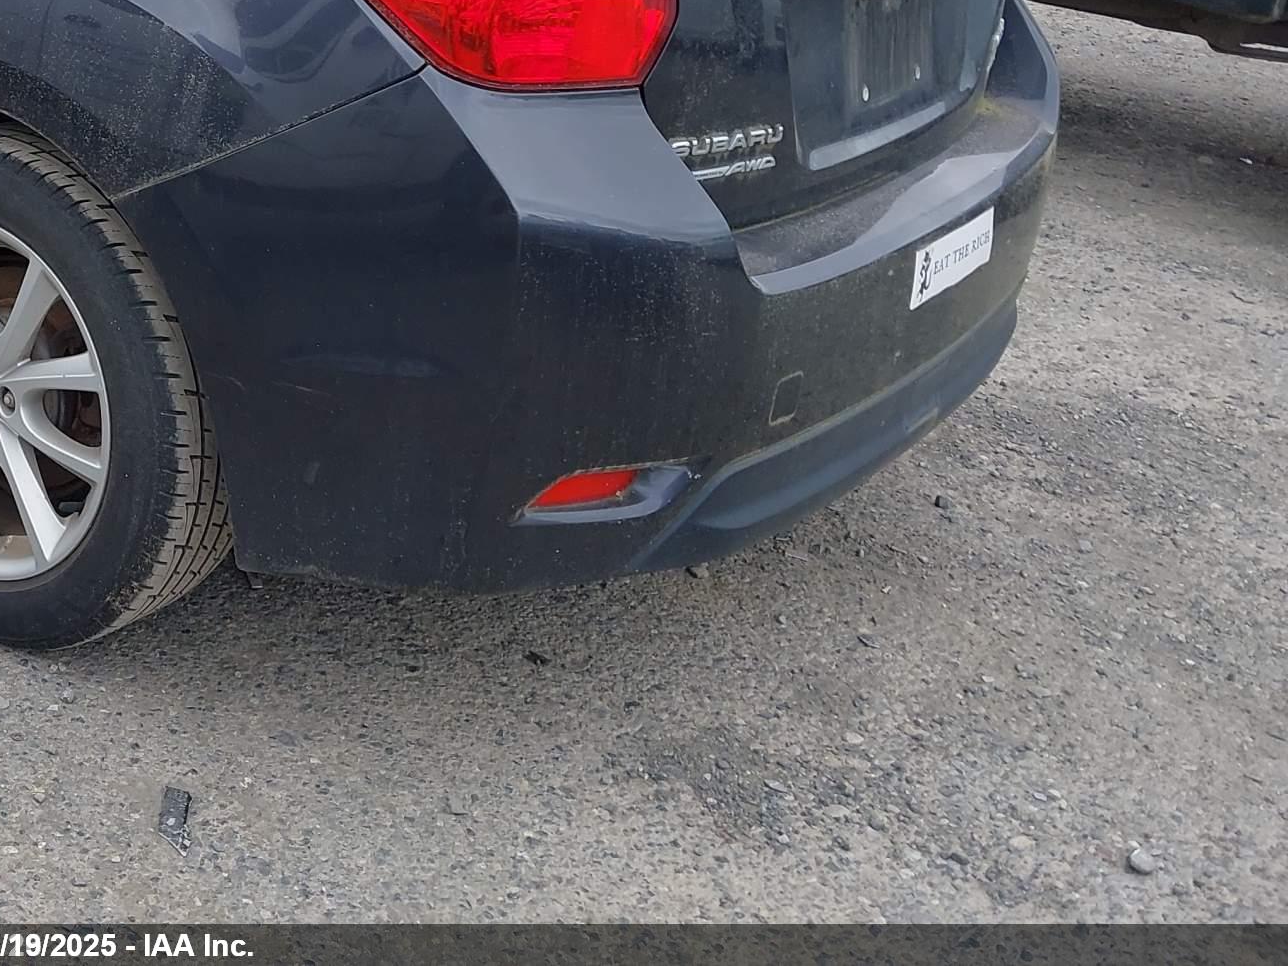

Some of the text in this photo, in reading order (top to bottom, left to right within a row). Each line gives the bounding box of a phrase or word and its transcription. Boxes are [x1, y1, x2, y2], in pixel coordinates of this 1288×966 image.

[671, 125, 784, 156] SUBARU
[725, 156, 776, 176] AWD
[933, 230, 991, 275] EAT THE RICH
